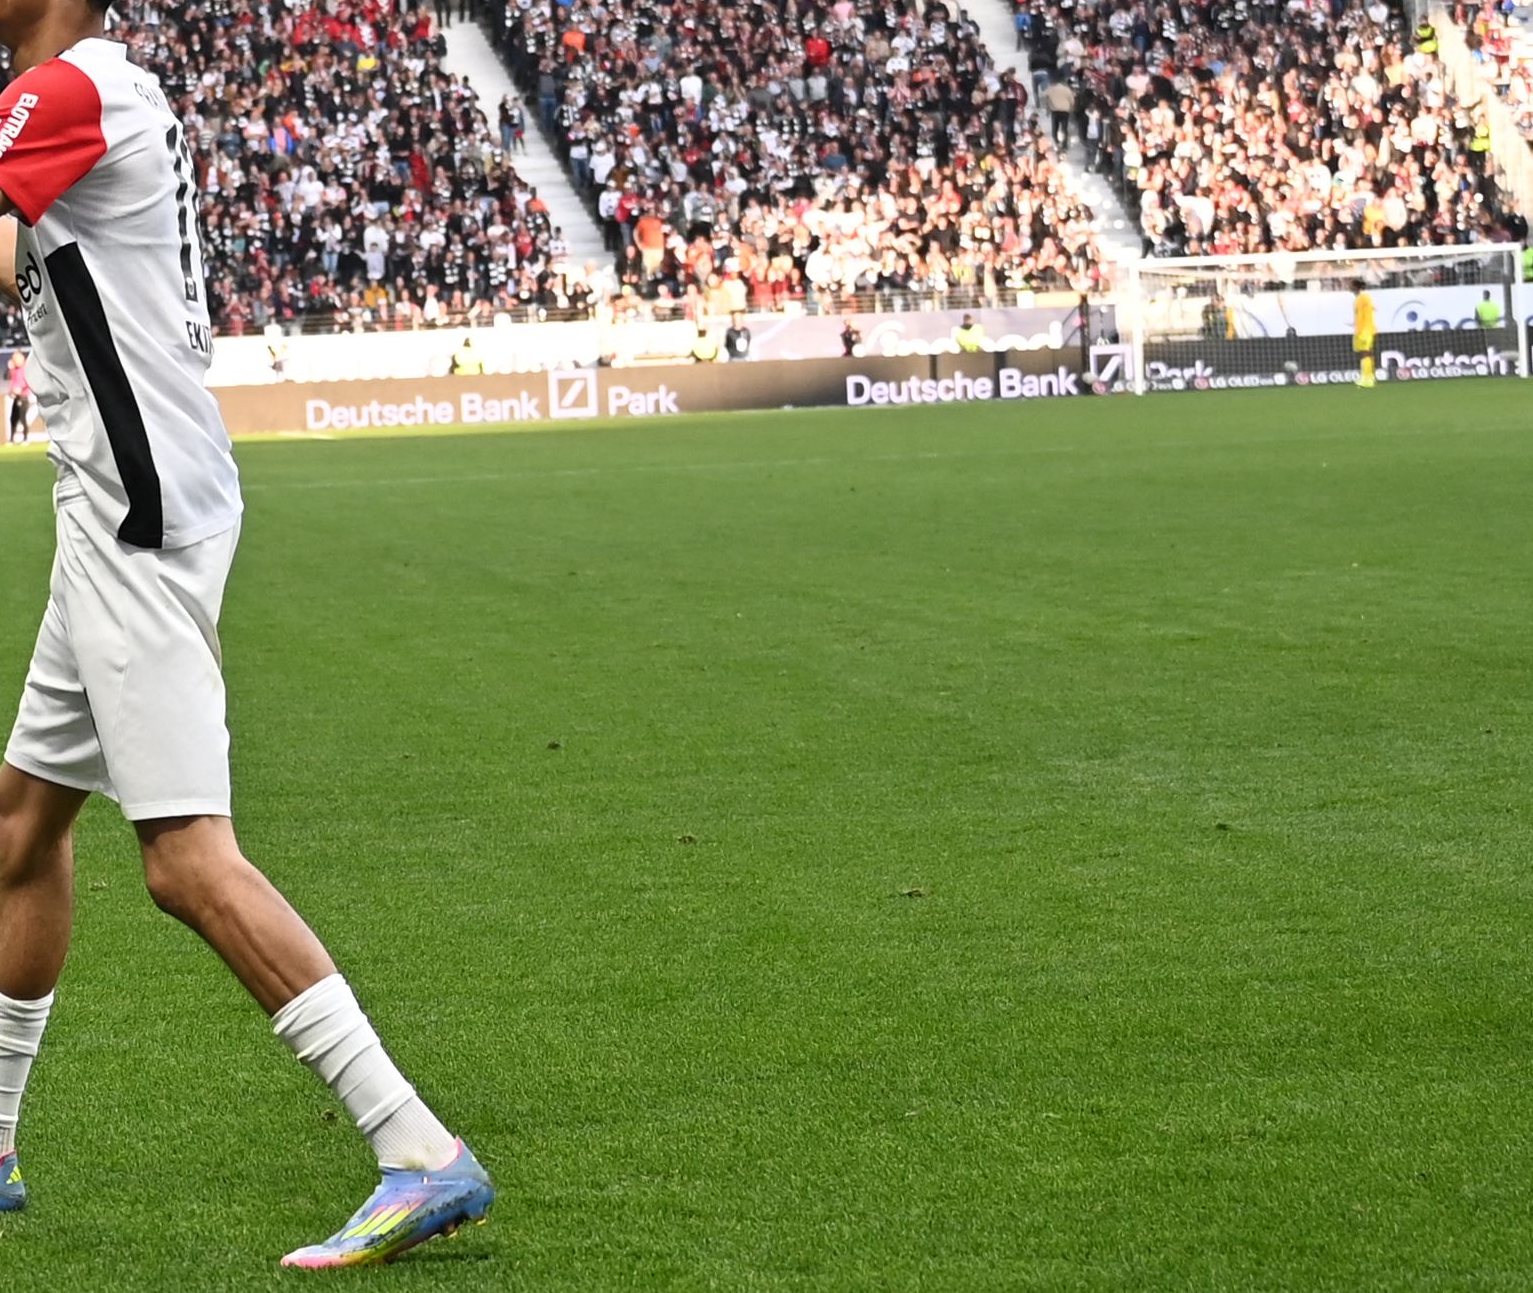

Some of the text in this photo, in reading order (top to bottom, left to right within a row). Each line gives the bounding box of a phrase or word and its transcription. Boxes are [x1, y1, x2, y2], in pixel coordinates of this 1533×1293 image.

[846, 371, 993, 405] Deutsche
[999, 366, 1078, 399] Bank
[306, 384, 678, 431] Deutsche Bank Park
